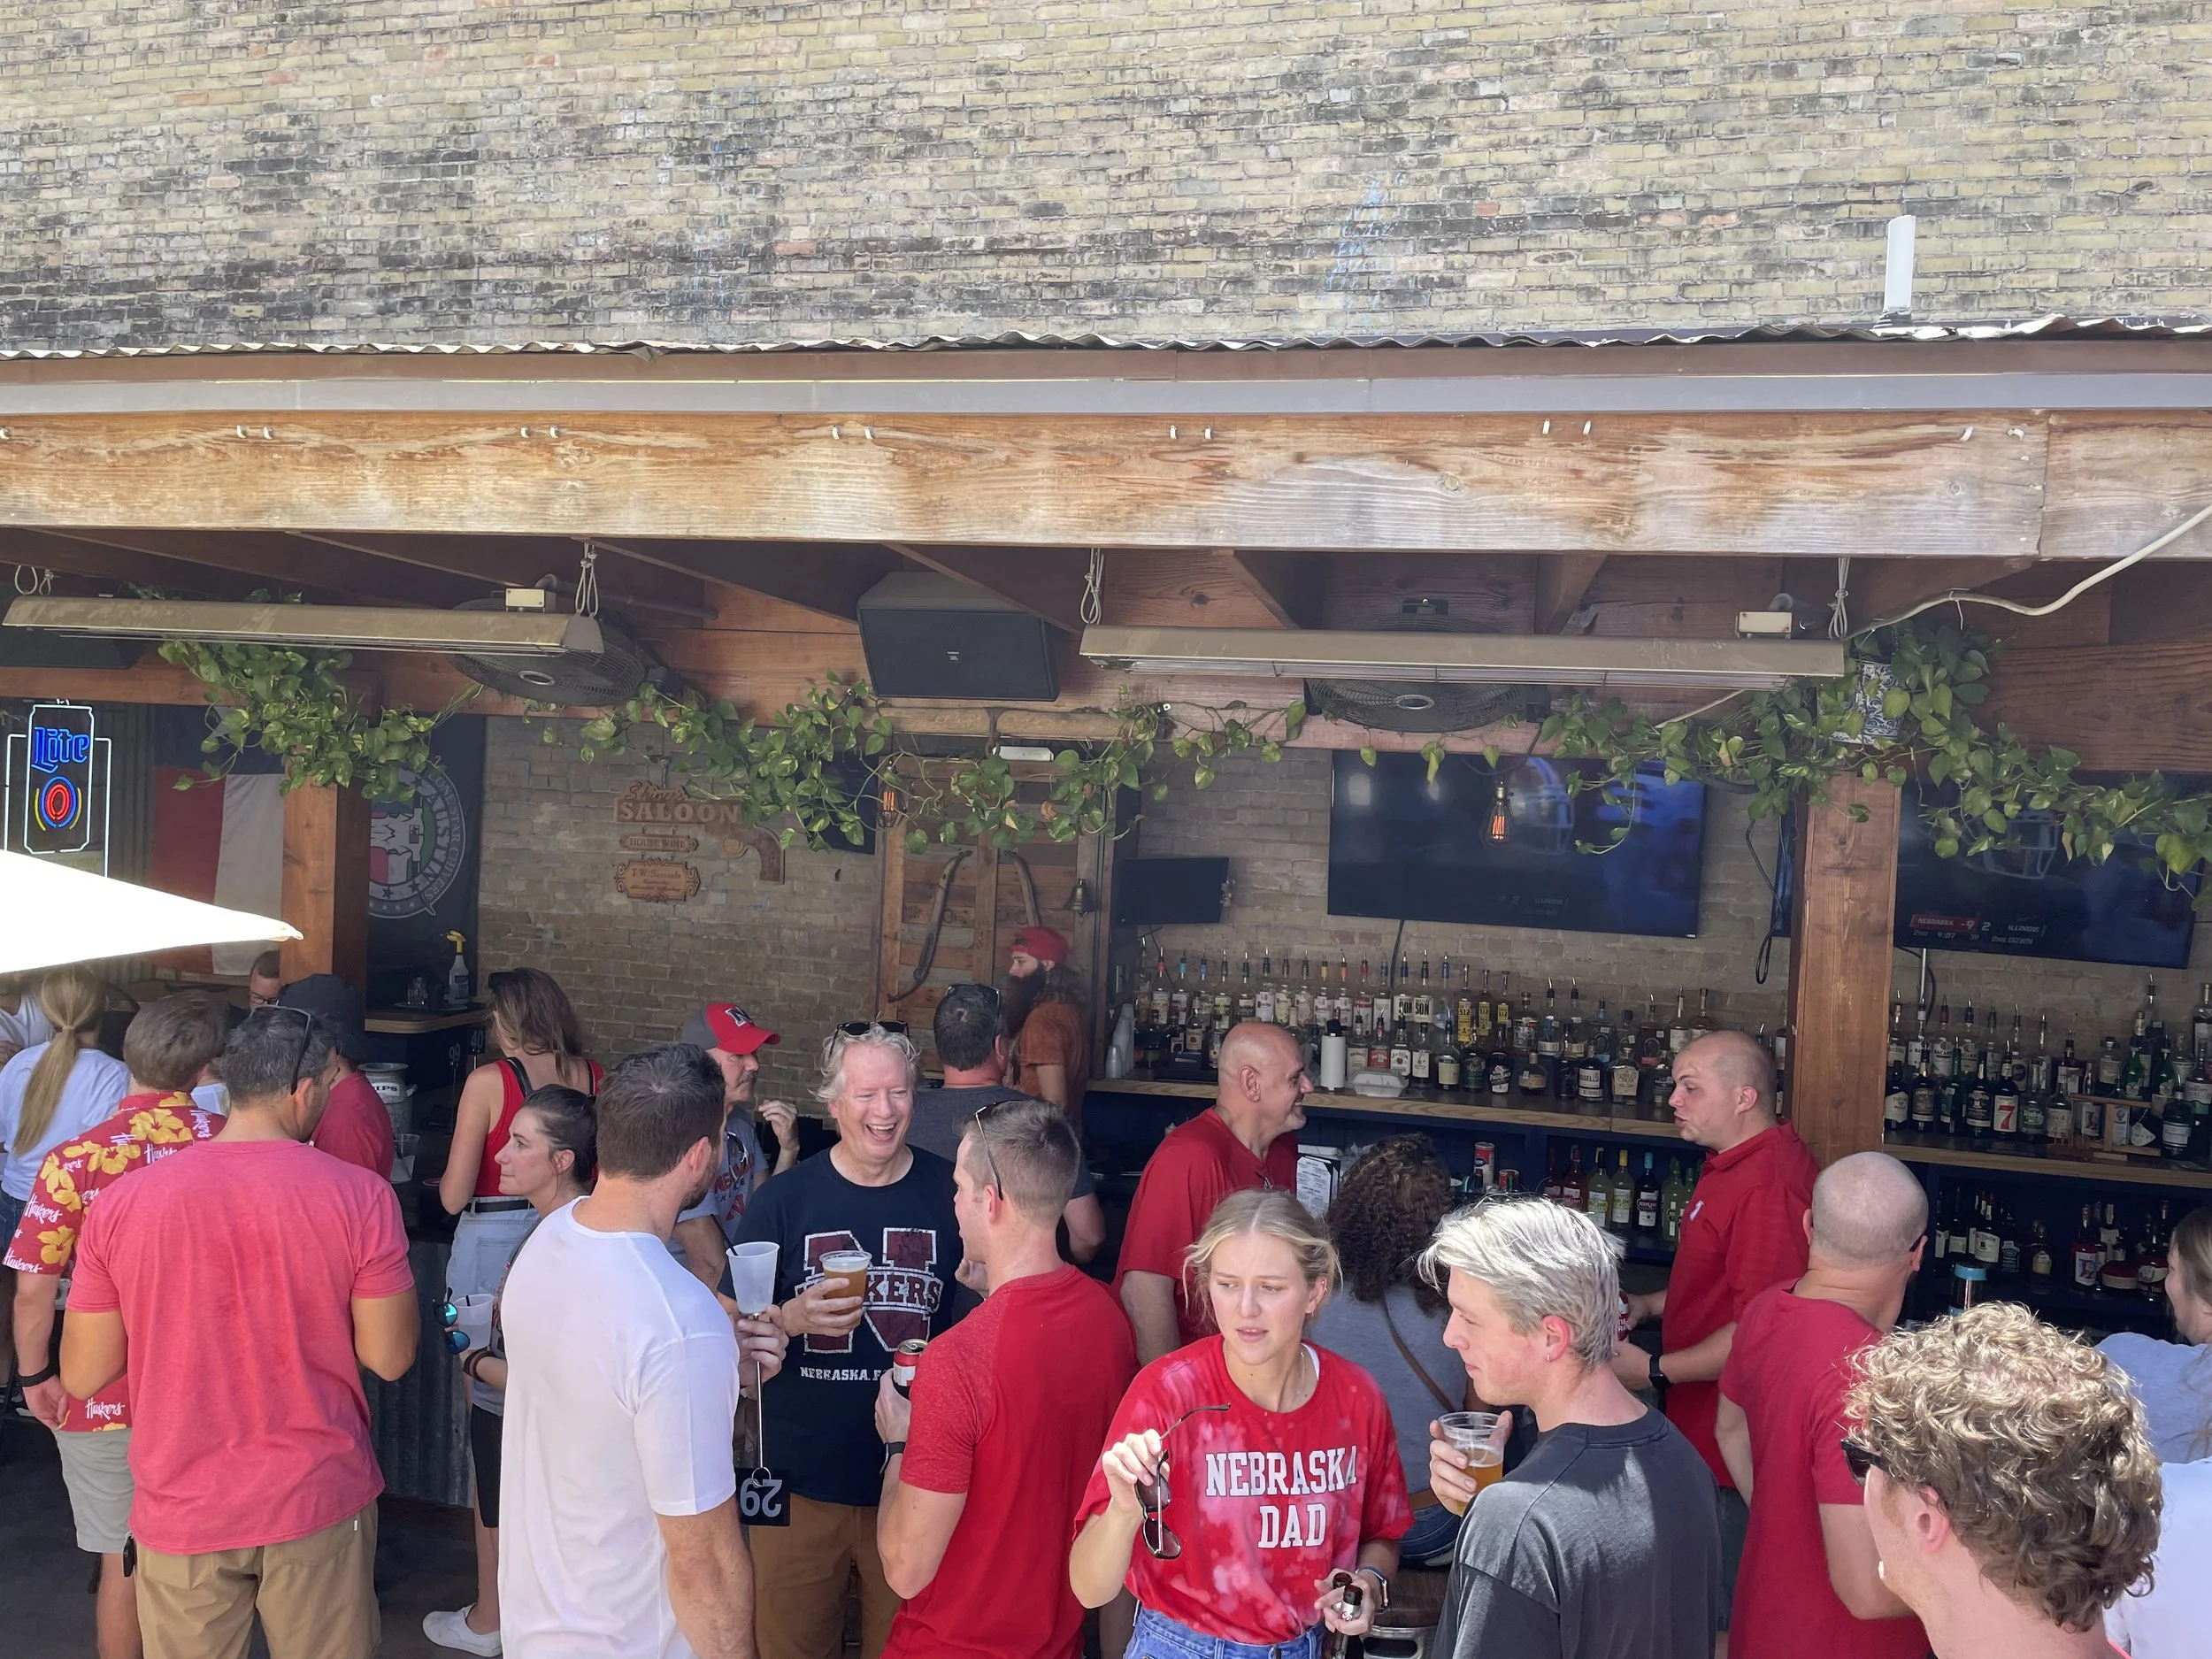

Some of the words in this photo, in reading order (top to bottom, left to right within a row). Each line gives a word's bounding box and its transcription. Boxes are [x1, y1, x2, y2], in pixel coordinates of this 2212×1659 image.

[31, 726, 90, 774] Lite
[625, 783, 687, 802] Shiner's
[449, 806, 461, 842] STAR
[619, 802, 740, 823] SALOON
[629, 837, 660, 848] HOUSE
[663, 839, 687, 849] WINE
[424, 847, 459, 901] CHIVERS
[1917, 918, 1954, 926] NEBRASKA
[1982, 921, 1991, 932] 2
[1938, 931, 1956, 940] 9:07
[1416, 1001, 1430, 1017] SON
[471, 1030, 484, 1049] 40
[1998, 1104, 2016, 1130] 7
[25, 1193, 64, 1225] Huskers
[85, 1397, 126, 1421] Huskers
[1205, 1444, 1358, 1497] NEBRASKA
[1256, 1502, 1327, 1549] DAD
